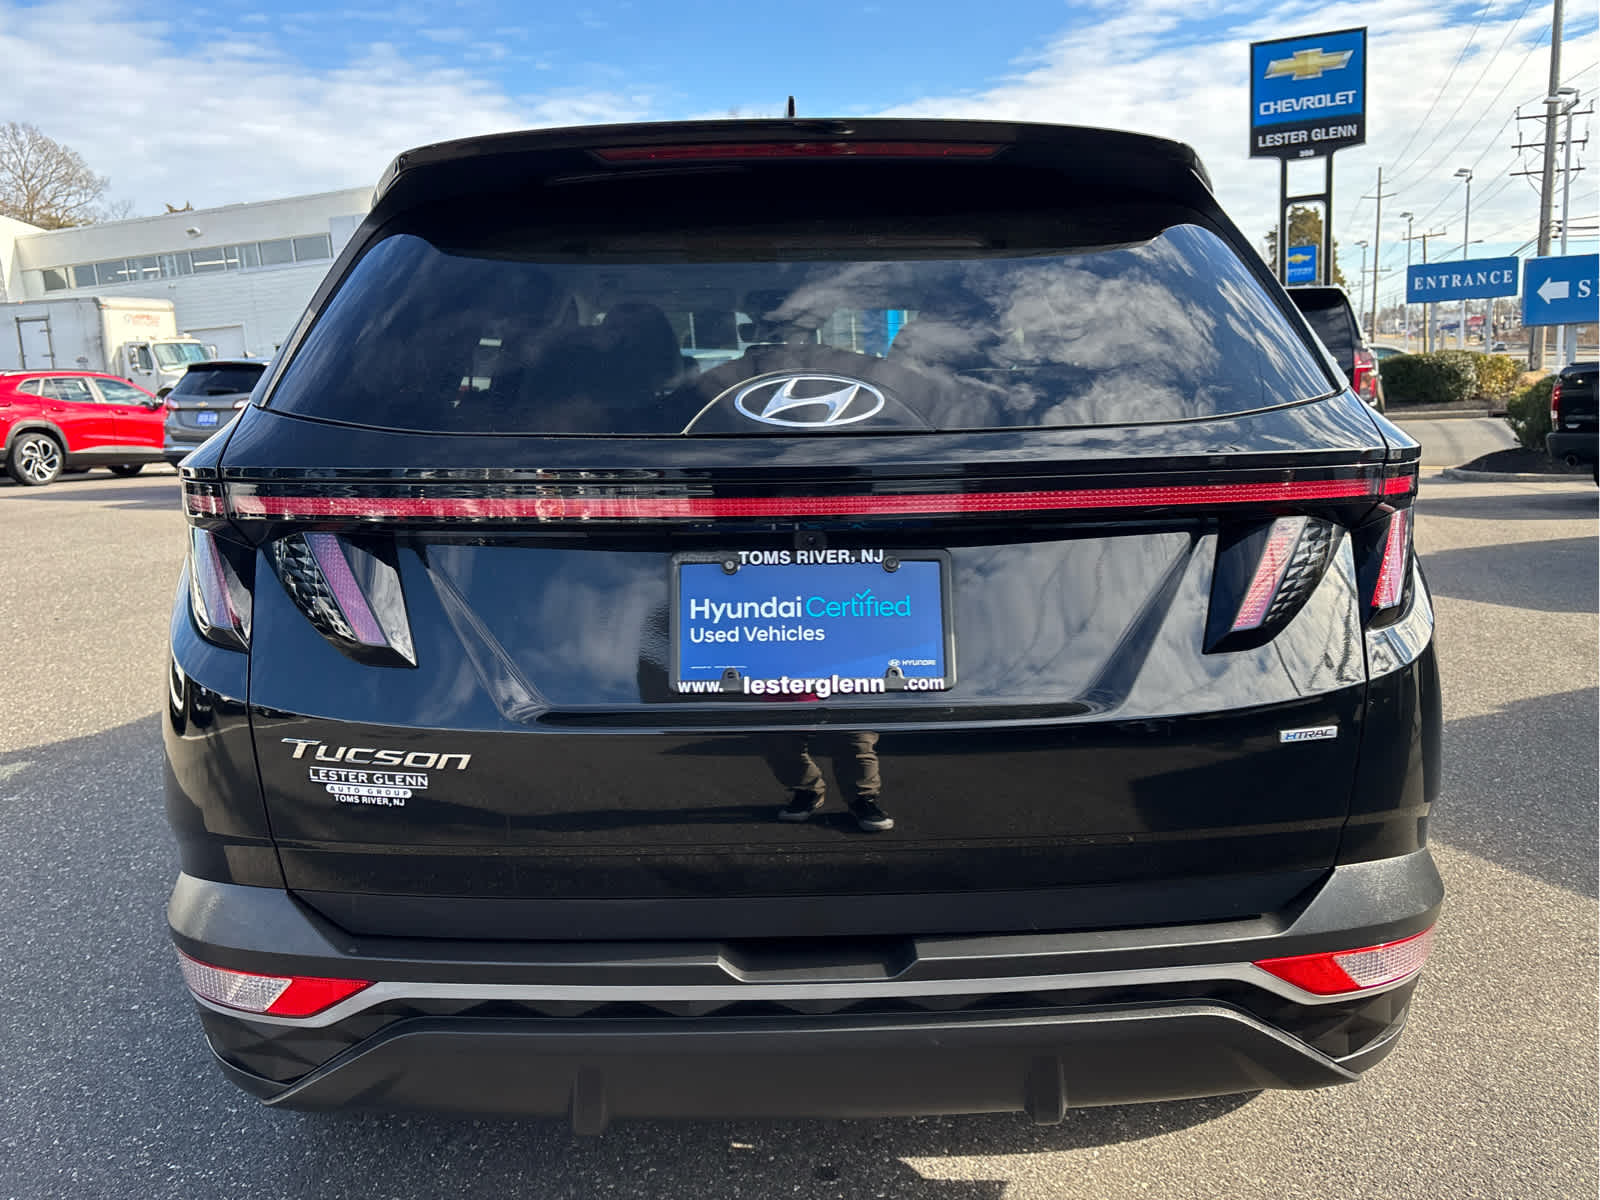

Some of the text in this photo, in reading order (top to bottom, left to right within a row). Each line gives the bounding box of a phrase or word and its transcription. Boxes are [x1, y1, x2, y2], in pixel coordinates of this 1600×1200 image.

[1259, 90, 1357, 116] CHEVROLET
[1257, 124, 1358, 148] LESTER GLENN
[1413, 270, 1513, 291] ENTRANCE
[738, 549, 884, 565] TOMS RIVER, NJ
[690, 588, 912, 624] Hyundai Certified
[690, 624, 825, 643] Used Vehicles
[677, 680, 724, 693] www.
[743, 675, 885, 699] lesterglenn
[1285, 729, 1334, 740] HTRAC
[309, 768, 428, 787] LESTER GLENN
[329, 786, 409, 797] AUTO GROUP
[334, 794, 360, 804] TOMS
[393, 799, 405, 807] NJ
